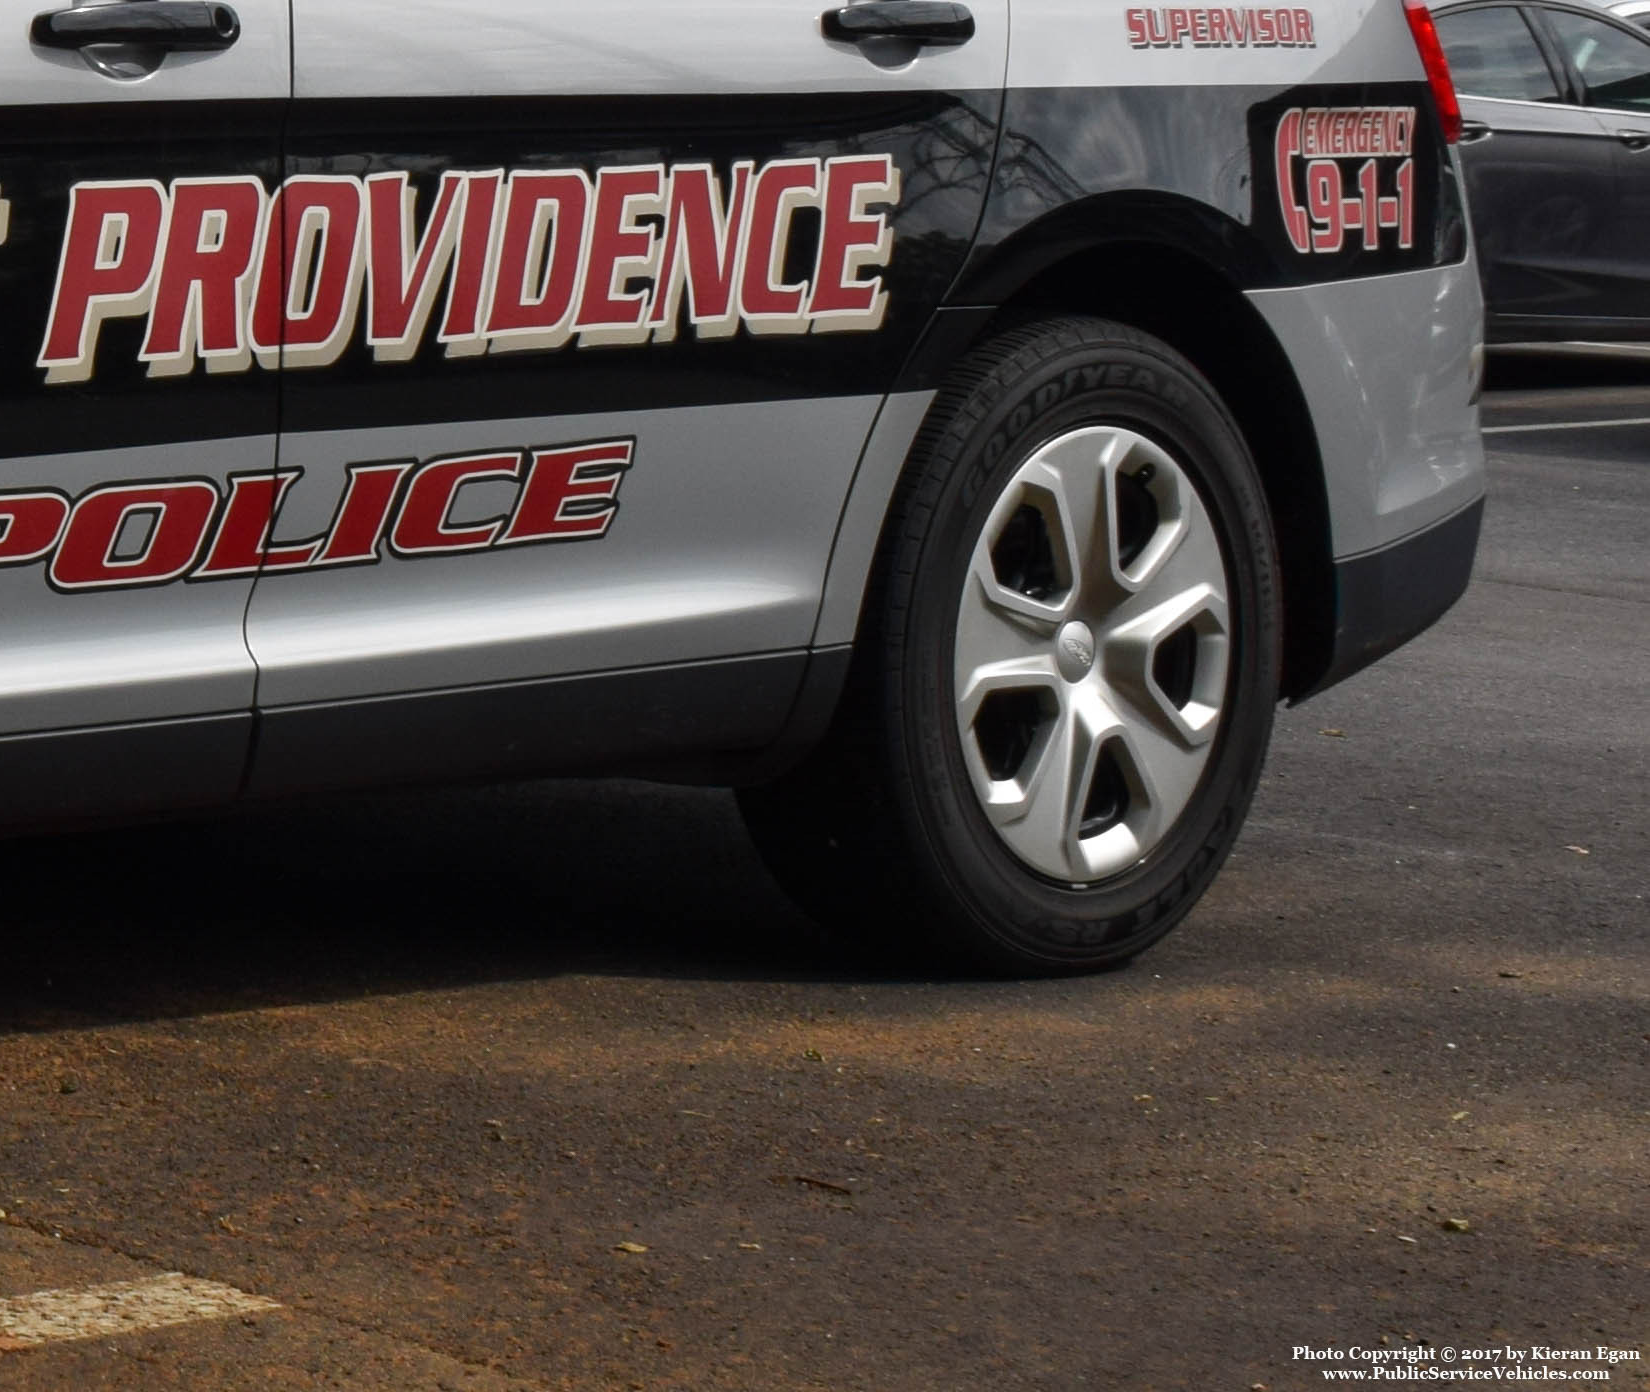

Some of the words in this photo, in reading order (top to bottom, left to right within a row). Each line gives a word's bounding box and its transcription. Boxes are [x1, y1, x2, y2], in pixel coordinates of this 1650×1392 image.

[1125, 7, 1316, 49] SUPERVISOR
[1301, 106, 1417, 157] EMERGENCY
[1305, 158, 1415, 254] 9-1-1
[36, 153, 902, 385] PROVIDENCE
[961, 362, 1190, 510] GOODYEAR
